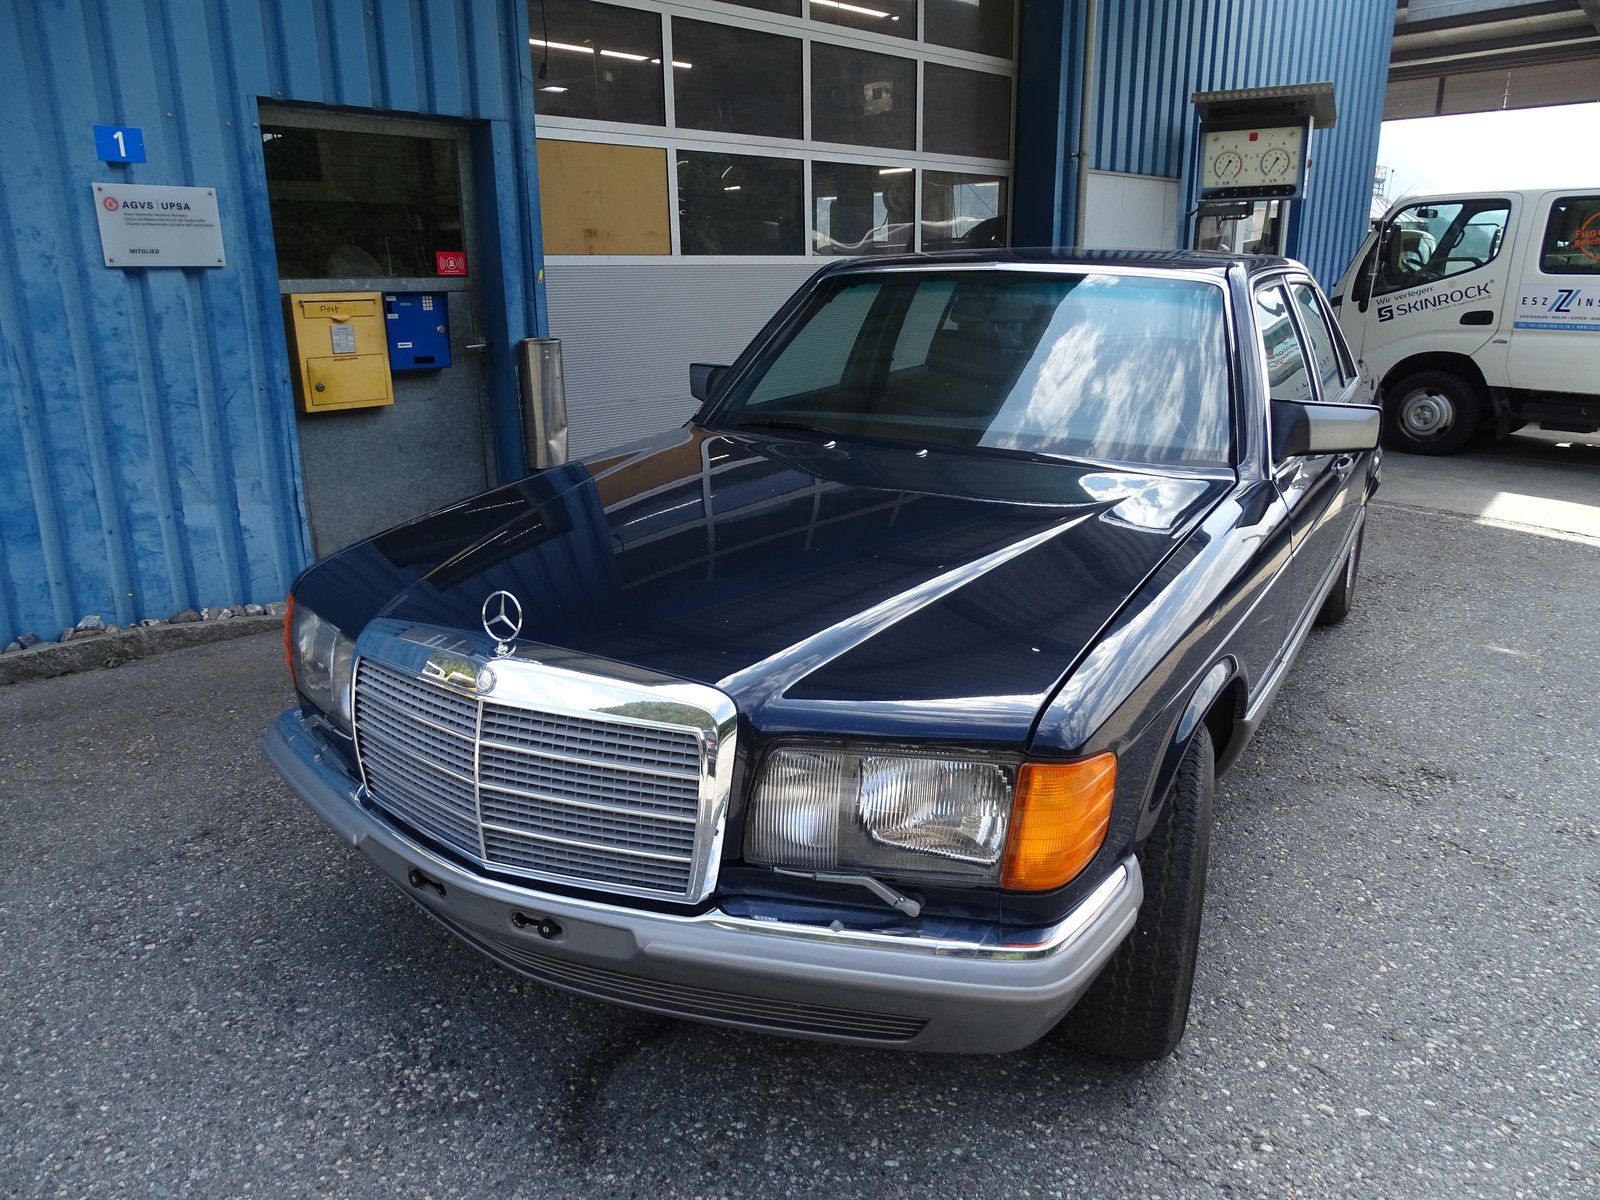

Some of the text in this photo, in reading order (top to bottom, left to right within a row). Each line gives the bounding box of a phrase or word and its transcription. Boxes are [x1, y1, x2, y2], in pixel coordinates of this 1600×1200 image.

[113, 131, 126, 157] 1
[122, 200, 191, 211] AGVS UPSA
[1376, 286, 1435, 305] Wir verlegen:
[1396, 283, 1490, 316] SKINROCK
[320, 305, 339, 314] Post
